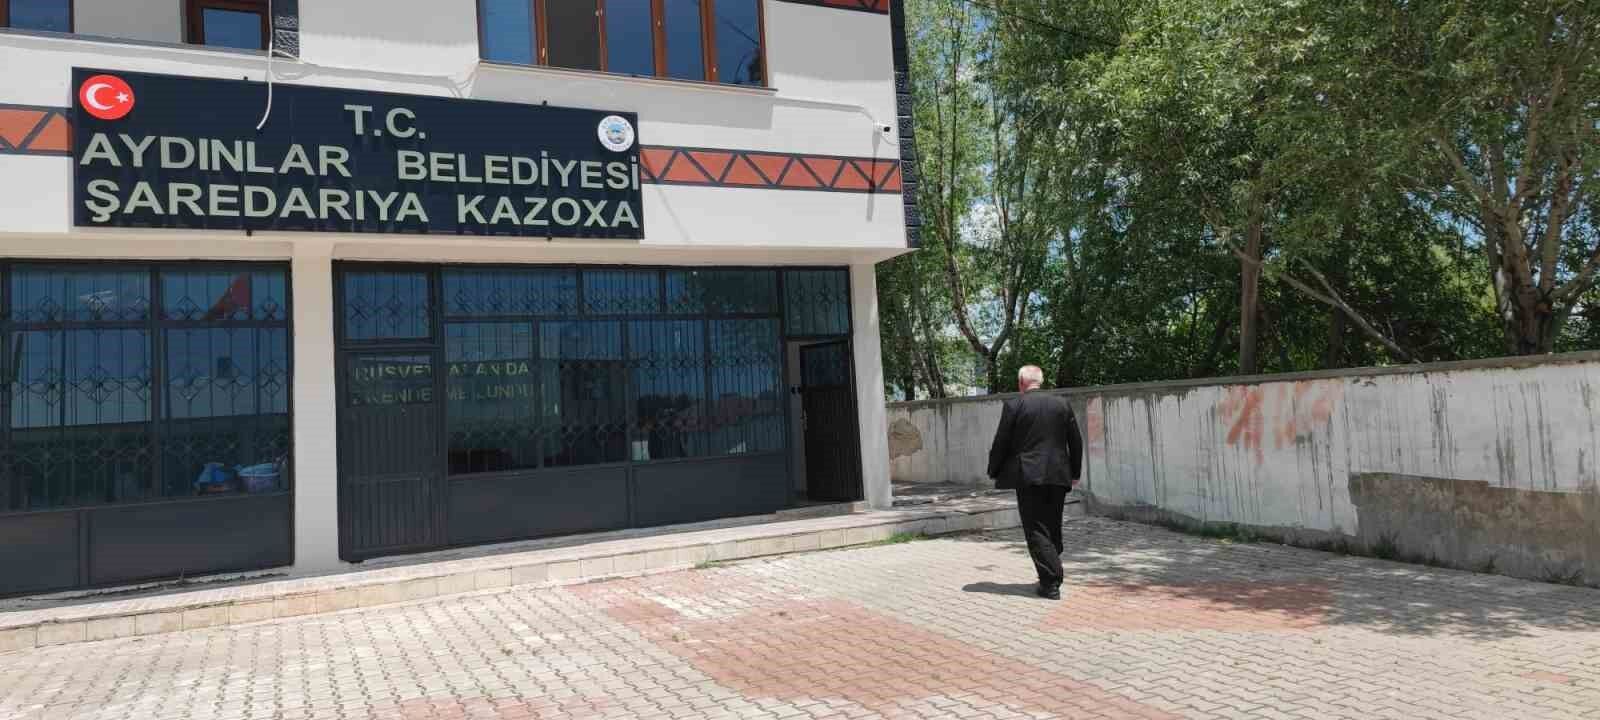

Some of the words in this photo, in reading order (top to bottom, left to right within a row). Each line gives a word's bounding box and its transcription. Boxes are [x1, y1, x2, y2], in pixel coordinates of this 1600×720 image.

[344, 104, 426, 139] T.C.
[80, 132, 352, 177] AYDINLAR
[397, 150, 639, 190] BELEDİYESİ
[85, 179, 429, 222] ŞAREDARIYA
[457, 194, 639, 228] KAZOXA
